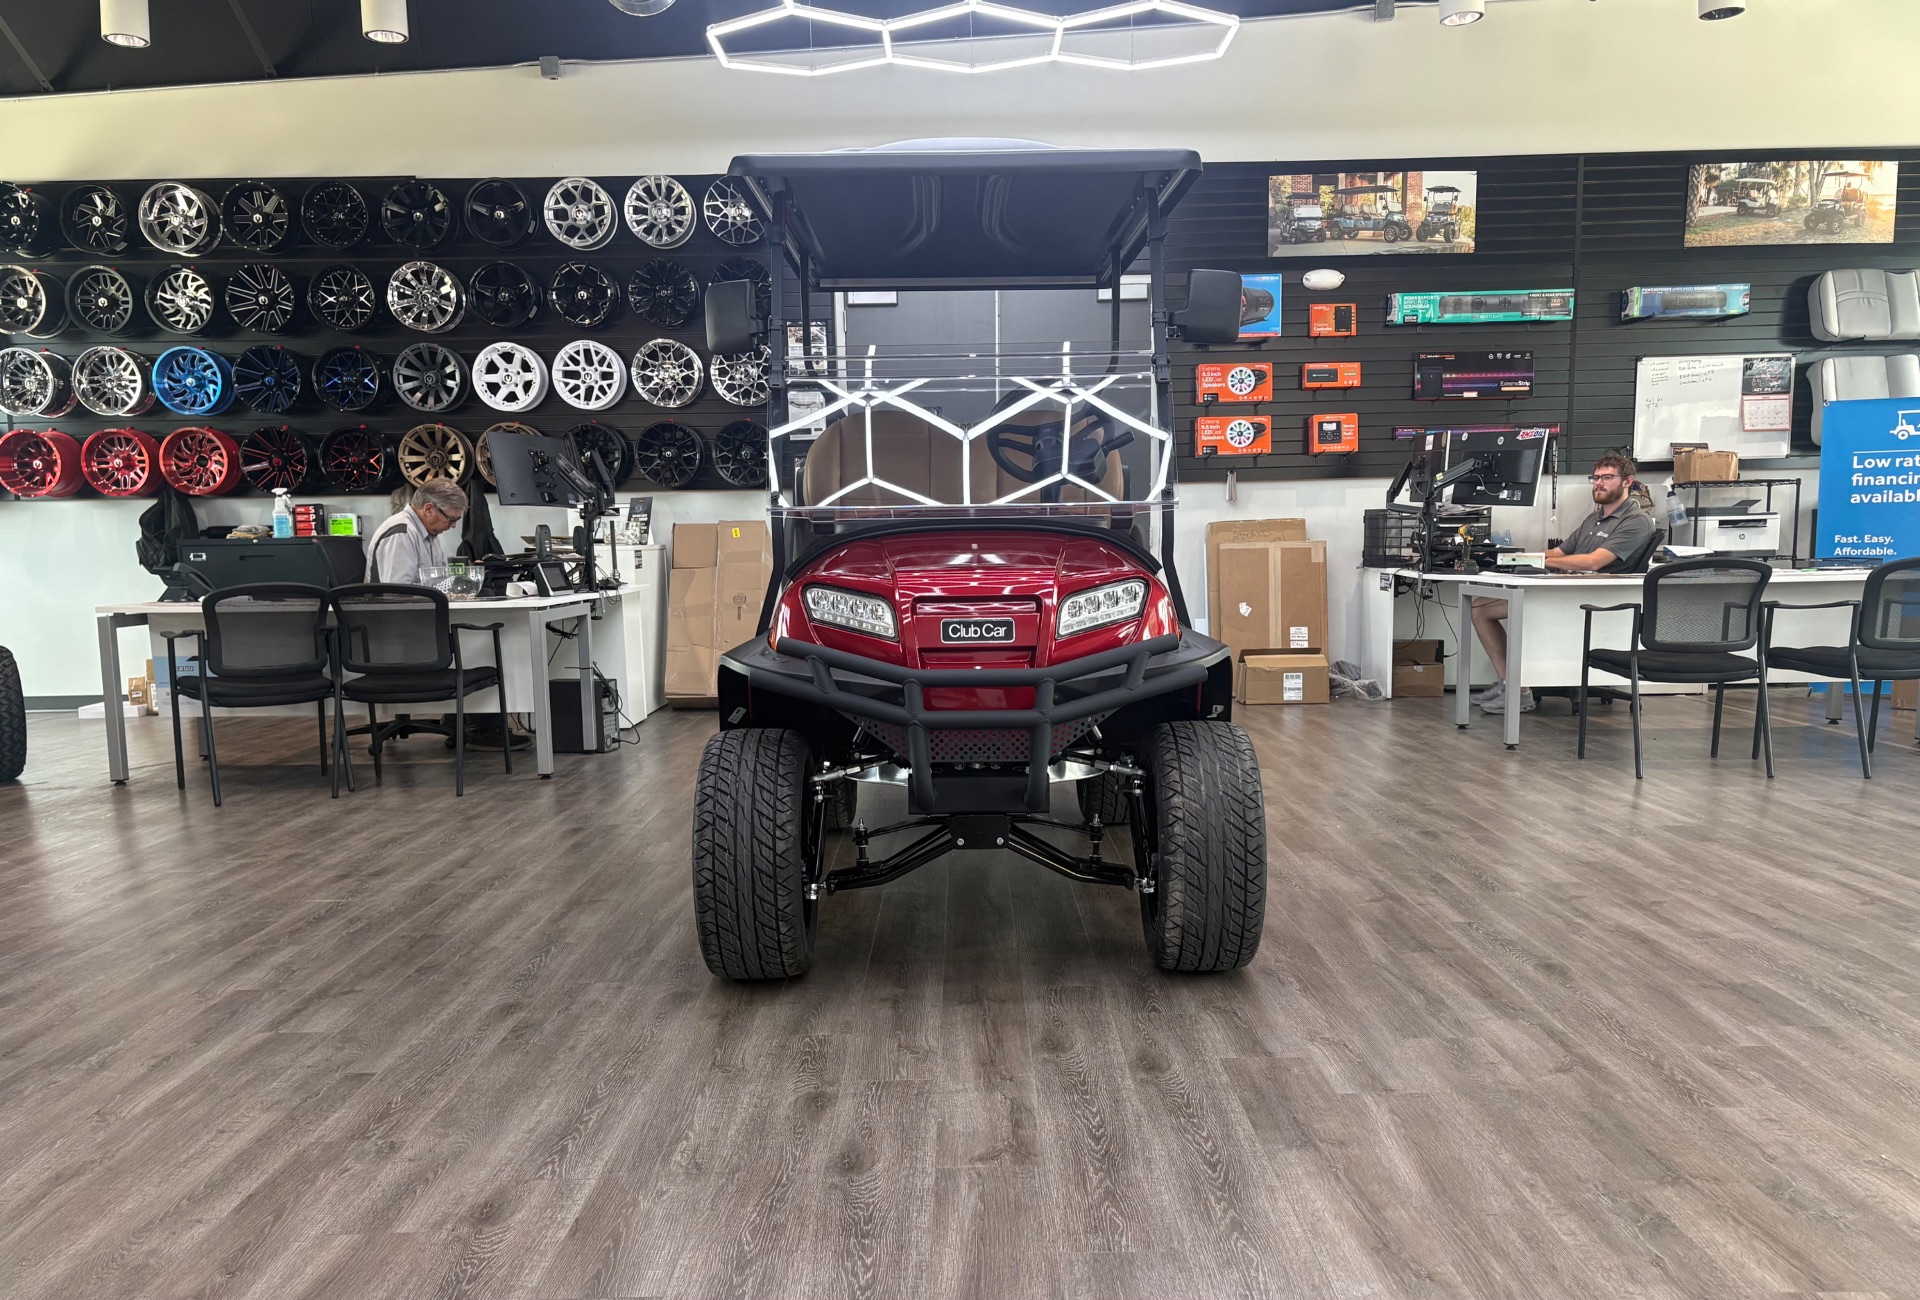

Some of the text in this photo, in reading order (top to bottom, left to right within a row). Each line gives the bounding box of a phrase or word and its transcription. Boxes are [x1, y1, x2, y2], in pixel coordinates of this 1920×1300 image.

[1521, 430, 1545, 439] AMSOIL
[1853, 455, 1891, 469] Low
[1834, 534, 1894, 545] Fast. Easy.
[1833, 546, 1897, 556] Affordable.
[948, 623, 1008, 638] Club Car
